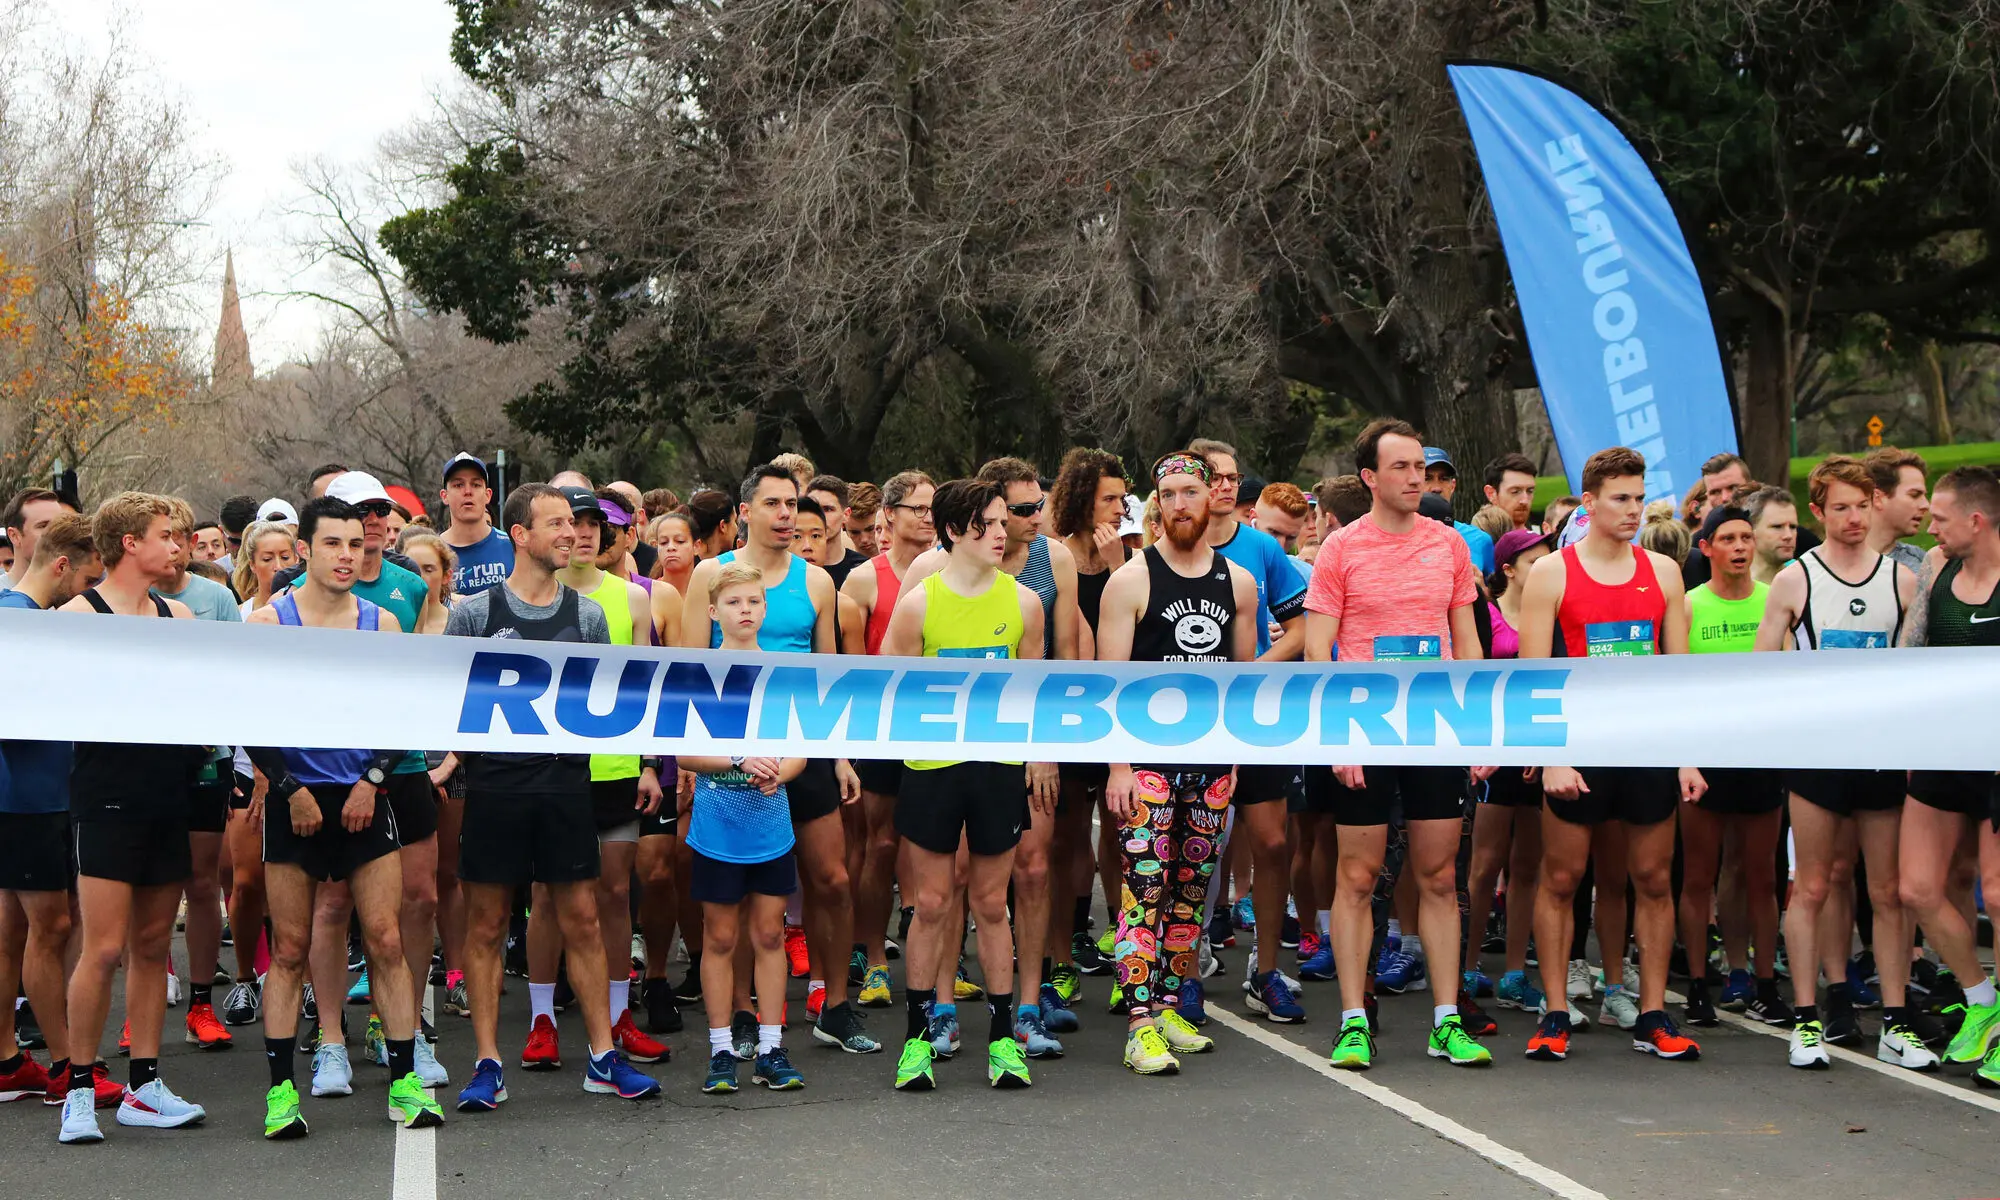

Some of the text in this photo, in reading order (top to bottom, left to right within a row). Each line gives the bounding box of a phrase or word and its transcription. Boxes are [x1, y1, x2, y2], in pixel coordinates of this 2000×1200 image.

[473, 562, 505, 578] run
[469, 574, 506, 588] REASON
[1161, 598, 1230, 626] WILL RUN
[1701, 625, 1721, 640] ELITE
[1589, 644, 1613, 653] 6242
[712, 771, 755, 781] CONNO
